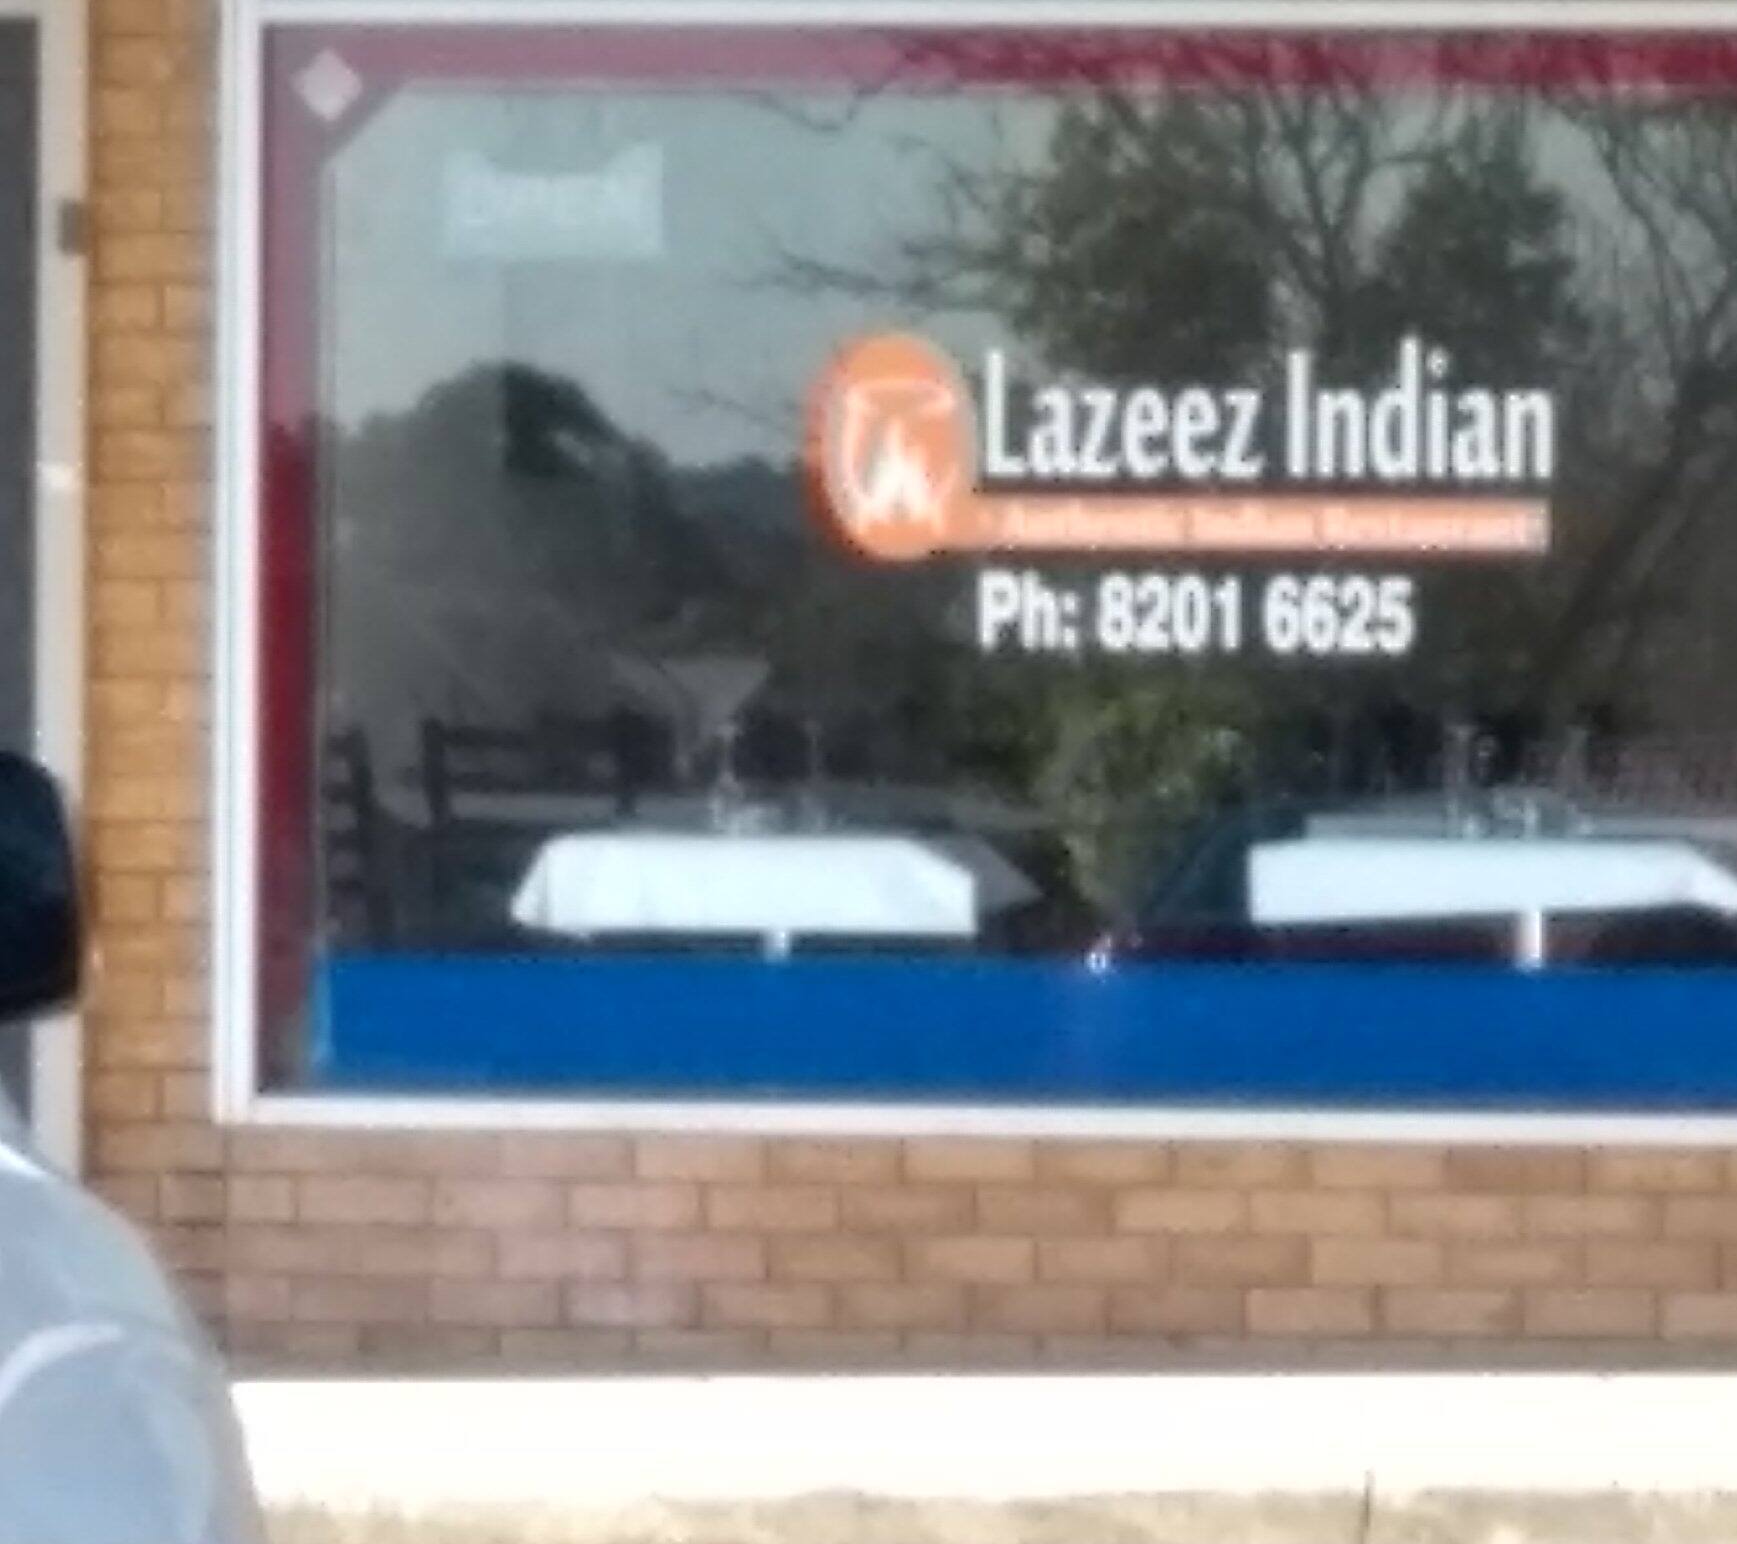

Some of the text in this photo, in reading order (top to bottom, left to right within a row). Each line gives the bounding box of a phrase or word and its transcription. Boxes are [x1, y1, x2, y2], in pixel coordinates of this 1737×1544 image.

[983, 334, 1554, 479] Lazeez Indian
[978, 570, 1414, 654] Ph: 8201 6625
